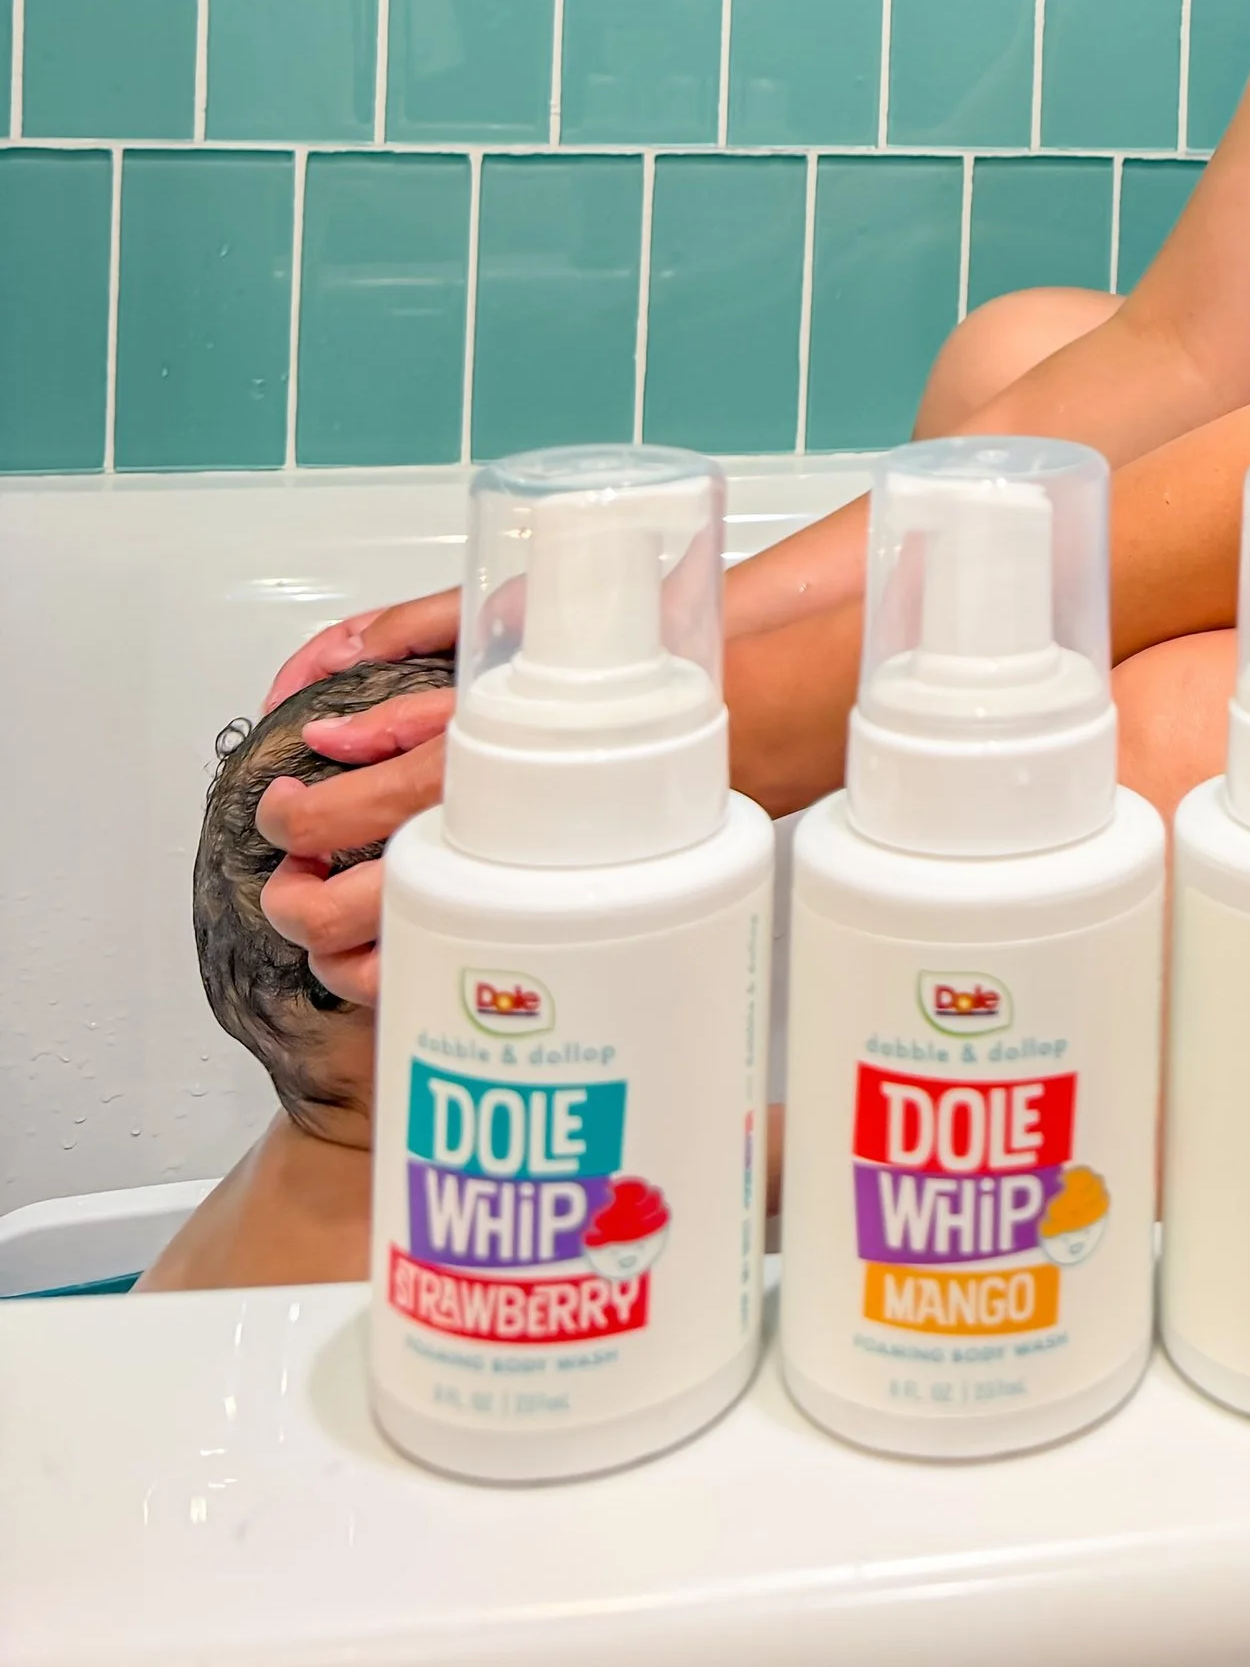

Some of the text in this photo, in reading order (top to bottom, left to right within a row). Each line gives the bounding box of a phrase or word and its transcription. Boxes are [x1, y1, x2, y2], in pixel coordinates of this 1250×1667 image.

[476, 982, 541, 1014] Dole
[934, 984, 1001, 1014] Dole
[417, 1029, 616, 1066] dabble & dollop
[866, 1032, 1068, 1064] dabble & dollop
[428, 1078, 588, 1177] DOLE
[880, 1082, 1044, 1171] DOLE
[393, 1264, 640, 1337] STRAWBERRY
[882, 1272, 1036, 1328] MANGO
